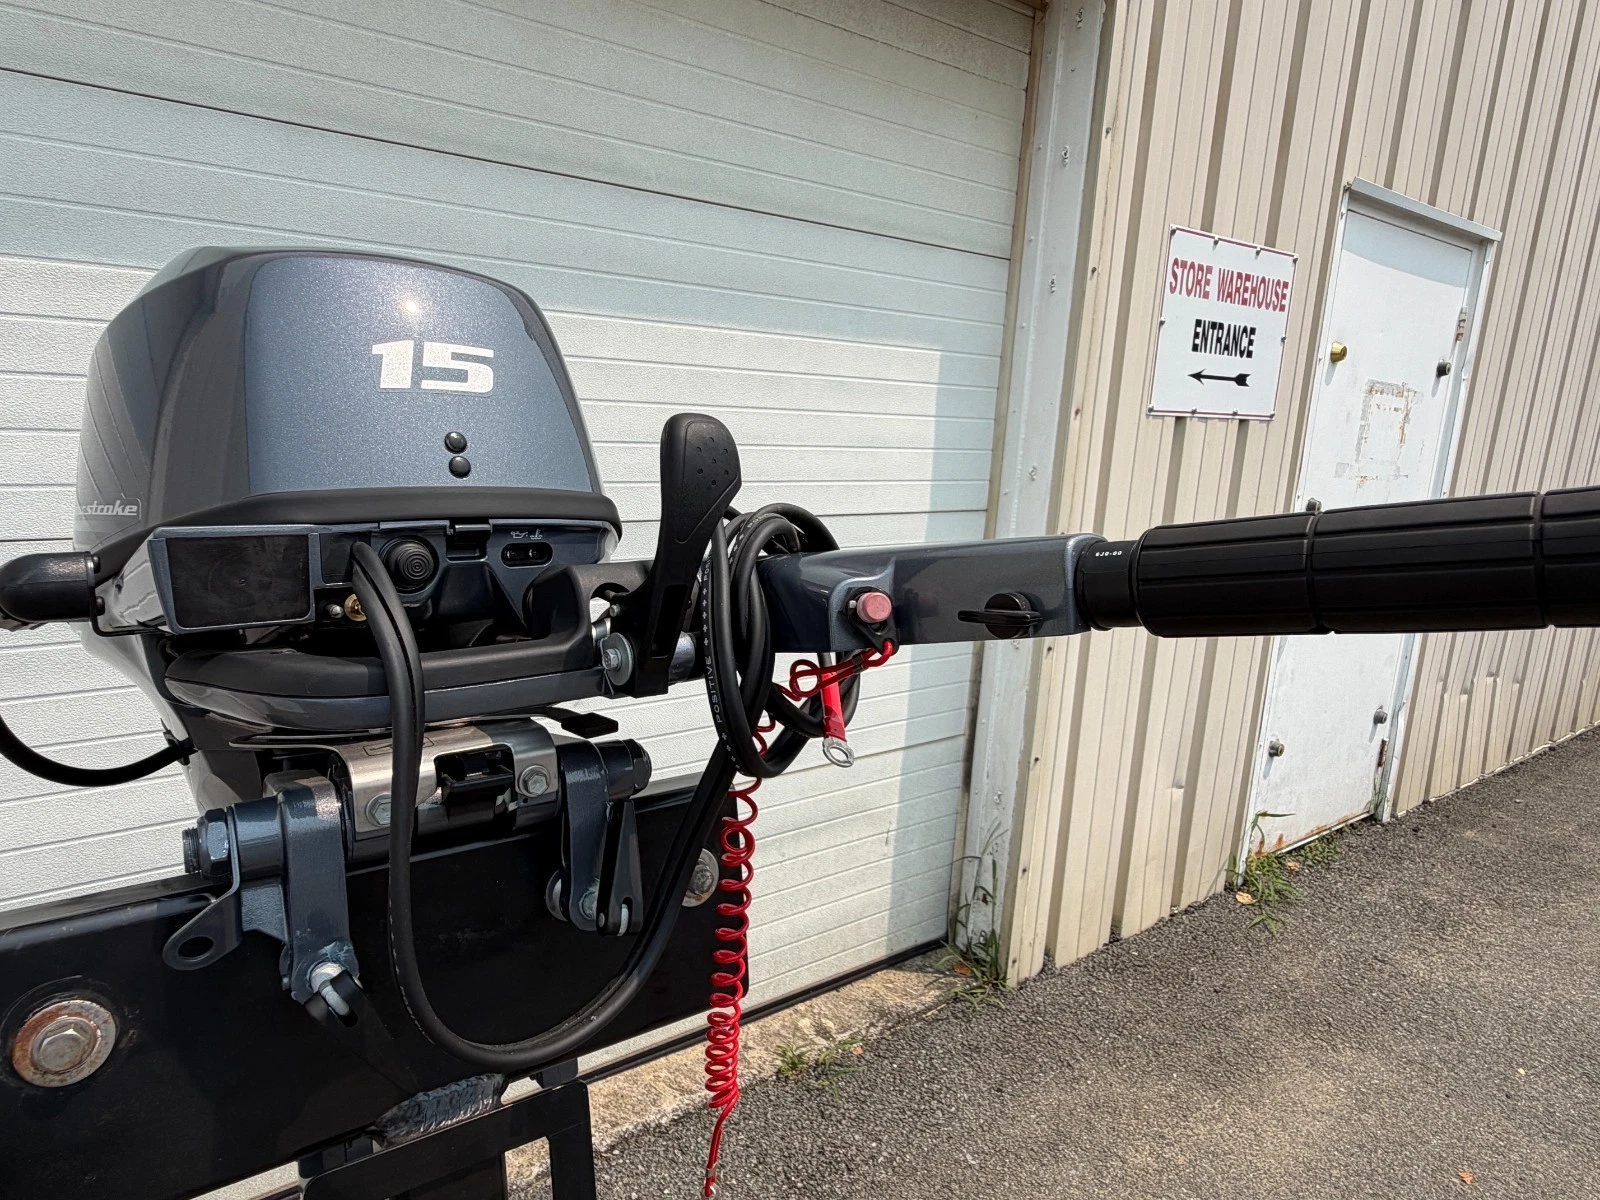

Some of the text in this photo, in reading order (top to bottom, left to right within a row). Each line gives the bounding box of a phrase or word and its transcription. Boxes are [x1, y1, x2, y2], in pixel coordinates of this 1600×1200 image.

[1169, 257, 1289, 313] STORE WAREHOUSE
[1191, 318, 1257, 359] ENTRANCE
[371, 339, 494, 394] 15
[704, 655, 723, 723] POSITIVE
